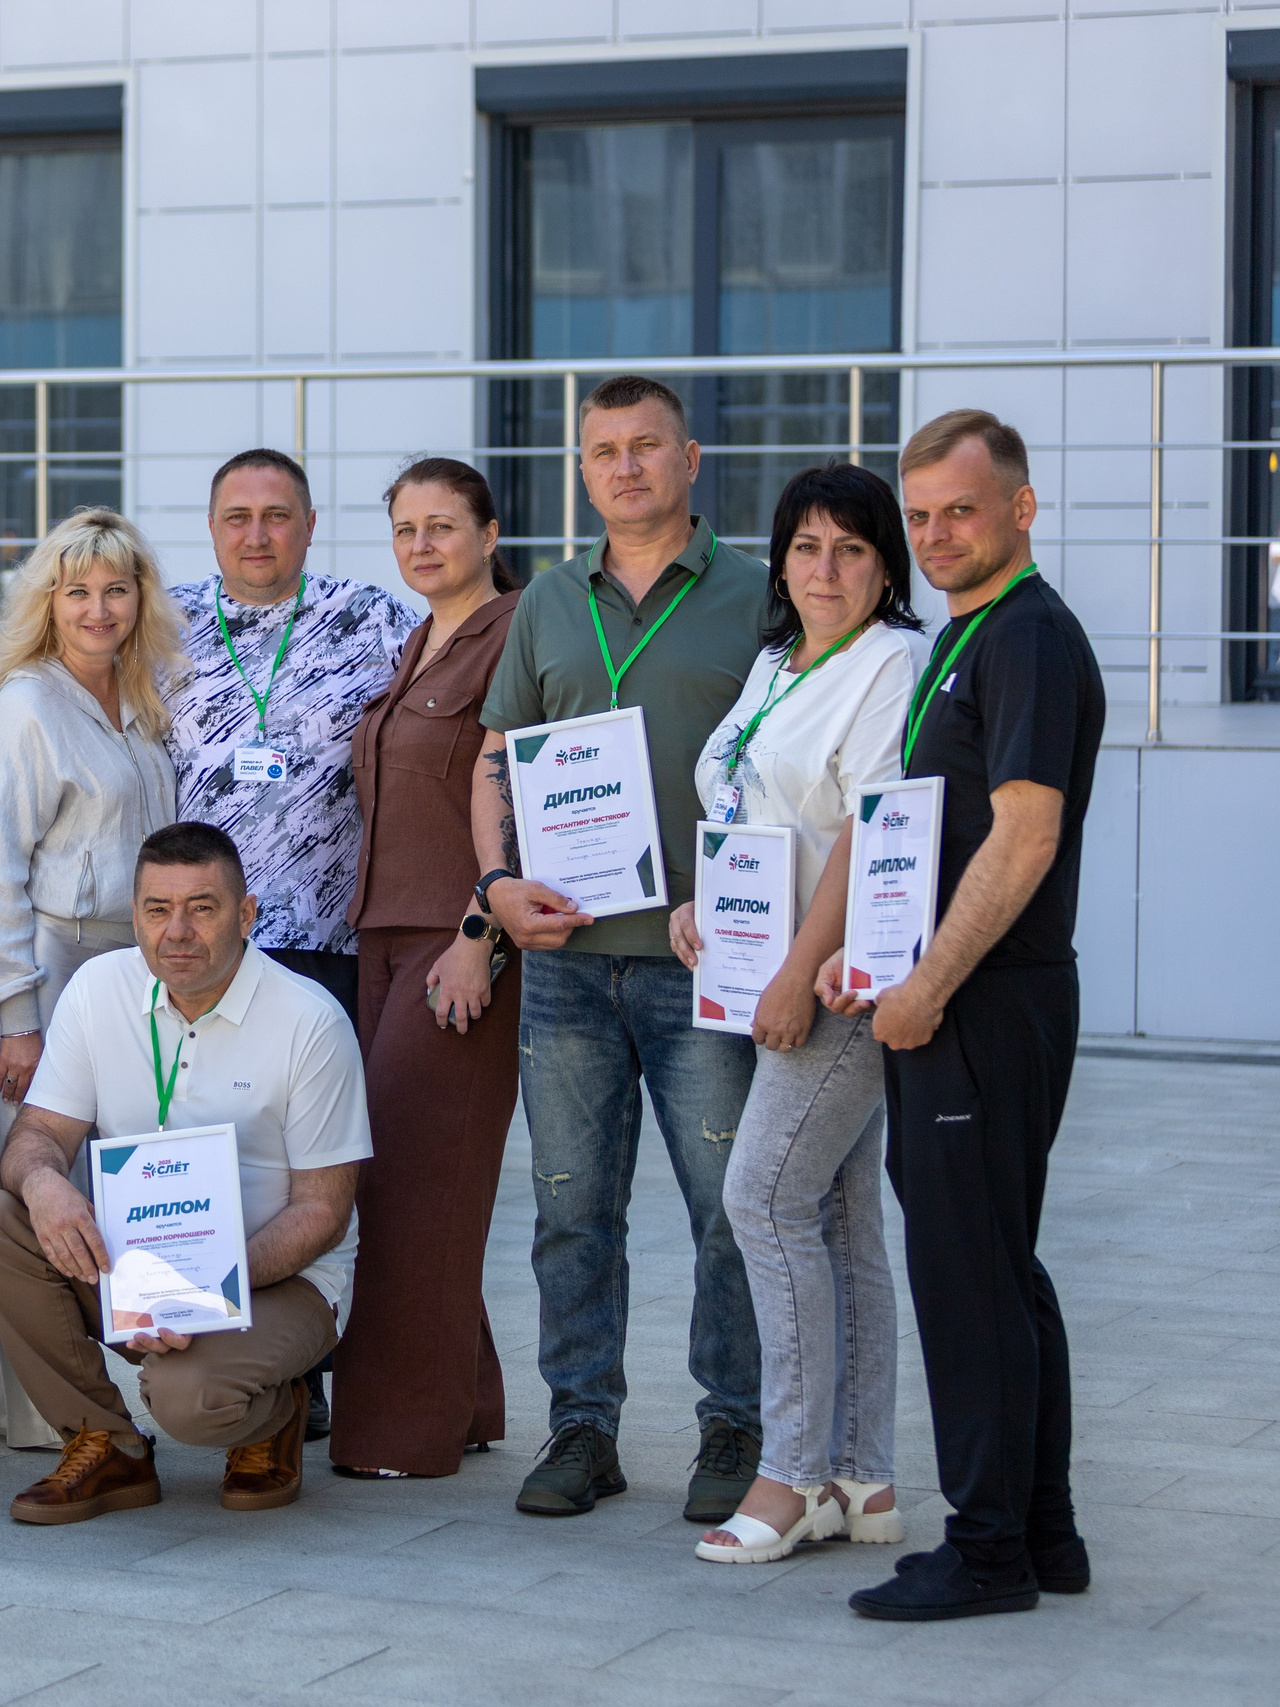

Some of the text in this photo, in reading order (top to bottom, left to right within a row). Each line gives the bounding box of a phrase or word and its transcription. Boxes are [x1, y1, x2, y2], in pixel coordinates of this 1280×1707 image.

[569, 745, 583, 753] 2025
[569, 746, 600, 762] СЛЁТ
[543, 781, 622, 811] ДИПЛОМ
[541, 818, 591, 833] КОНСТАНТИНУ
[591, 811, 631, 823] ЧИСТЯКОВУ
[890, 814, 910, 827] СЛЁТ
[738, 858, 760, 870] СЛЁТ
[867, 856, 917, 877] ДИПЛОМ
[715, 896, 771, 915] ДИПЛОМ
[157, 1160, 190, 1174] СЛЁТ
[126, 1198, 210, 1224] ДИПЛОМ
[126, 1235, 163, 1245] ВИТАЛИЮ
[163, 1229, 216, 1241] КОРНЮШЕНКО
